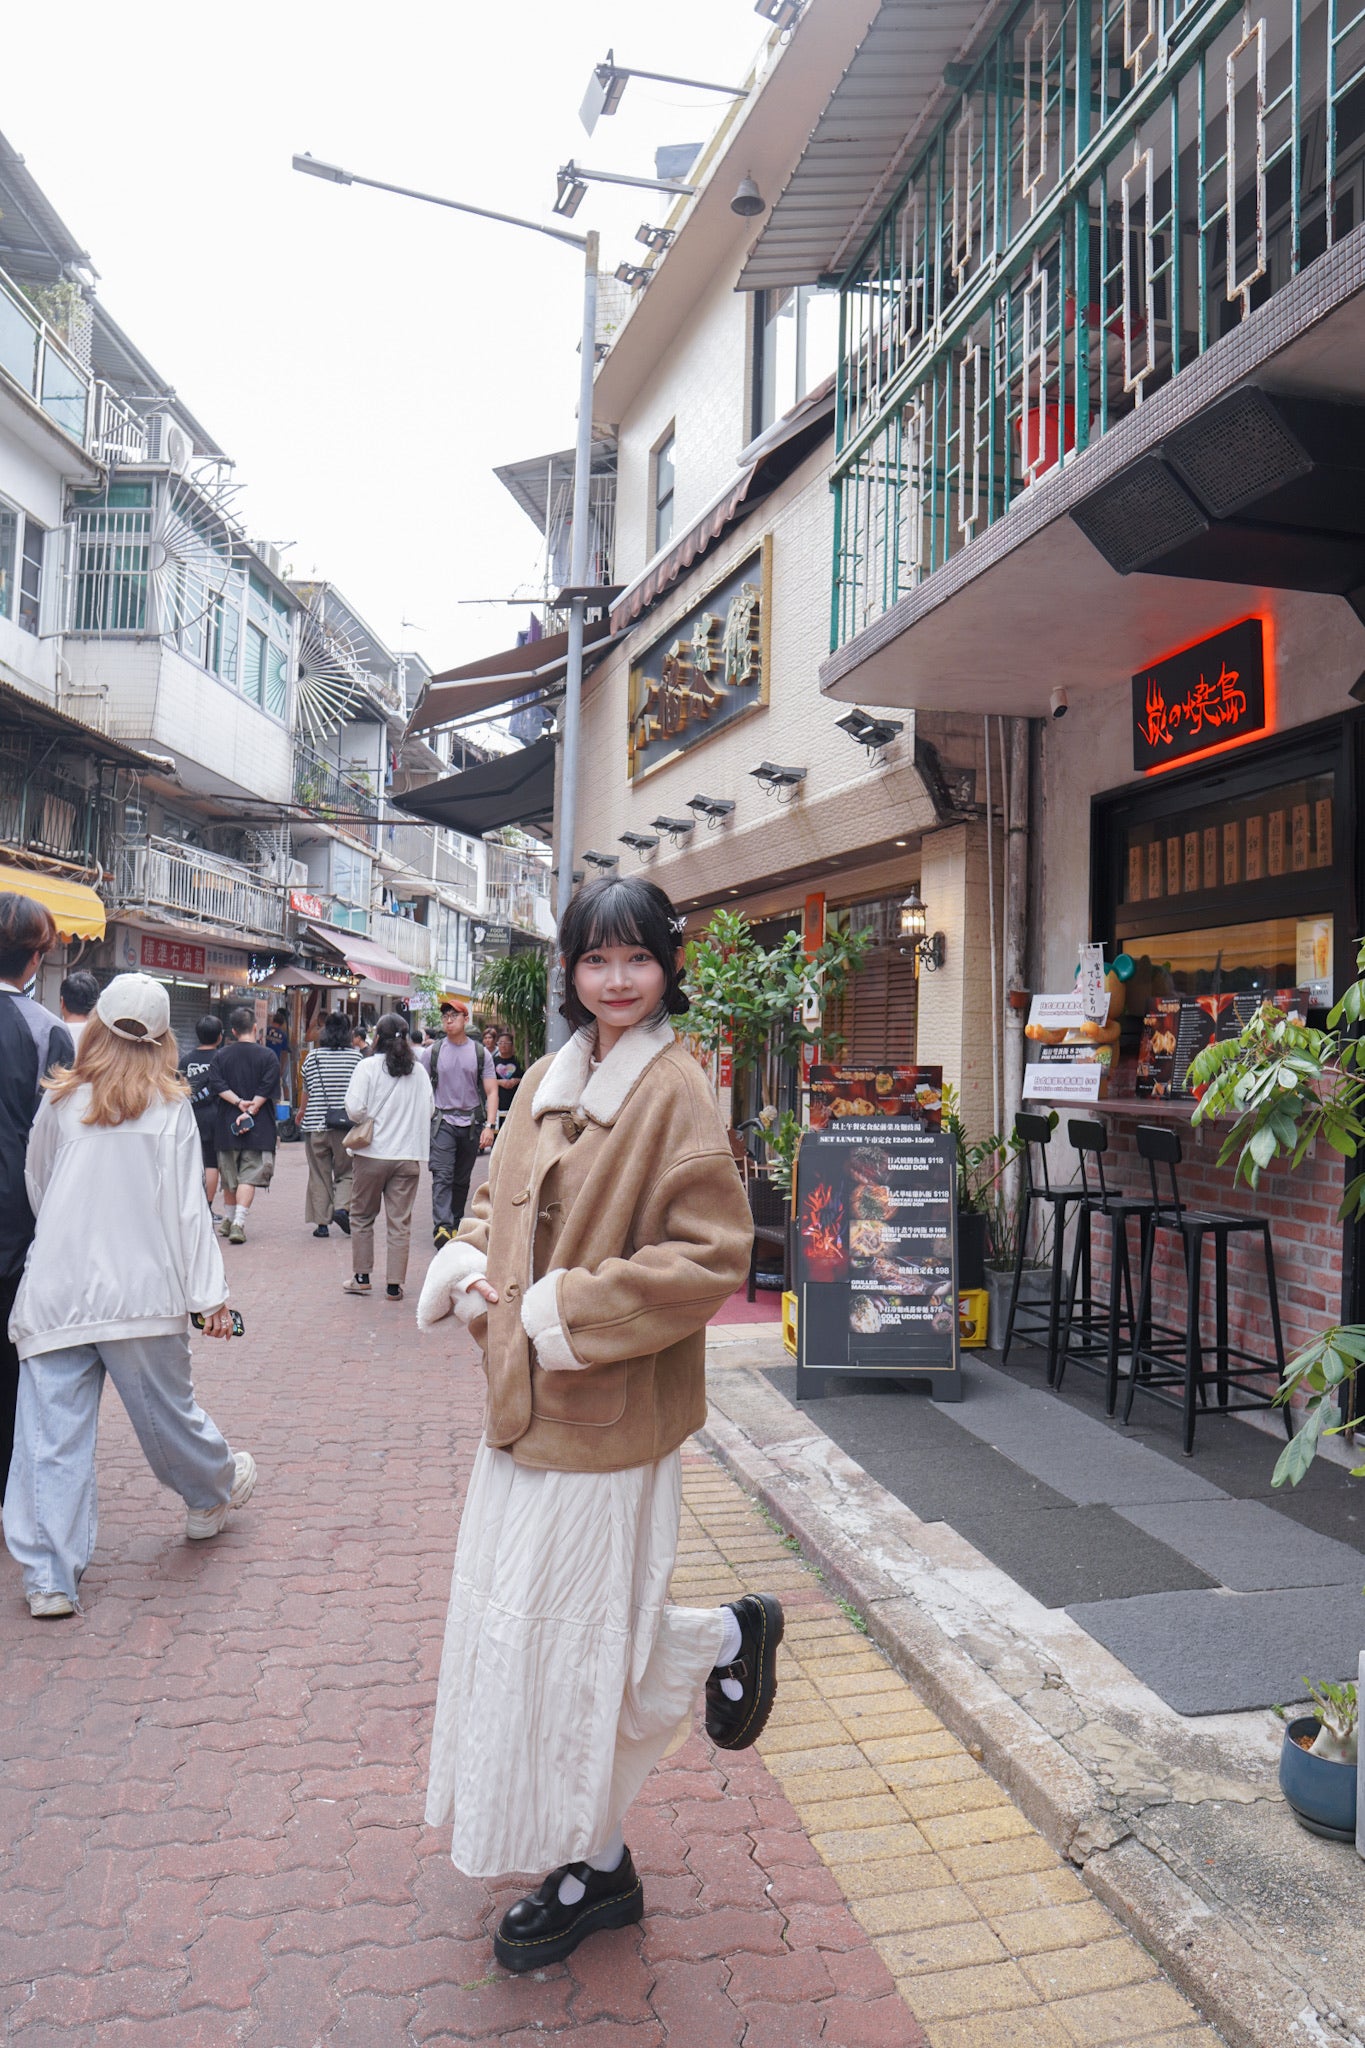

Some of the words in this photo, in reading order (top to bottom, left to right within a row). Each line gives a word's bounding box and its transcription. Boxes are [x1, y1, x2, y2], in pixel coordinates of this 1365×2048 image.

[144, 940, 204, 971] 標準石油氣
[1087, 970, 1096, 1013] てんこもり
[865, 1136, 892, 1144] 午市定食
